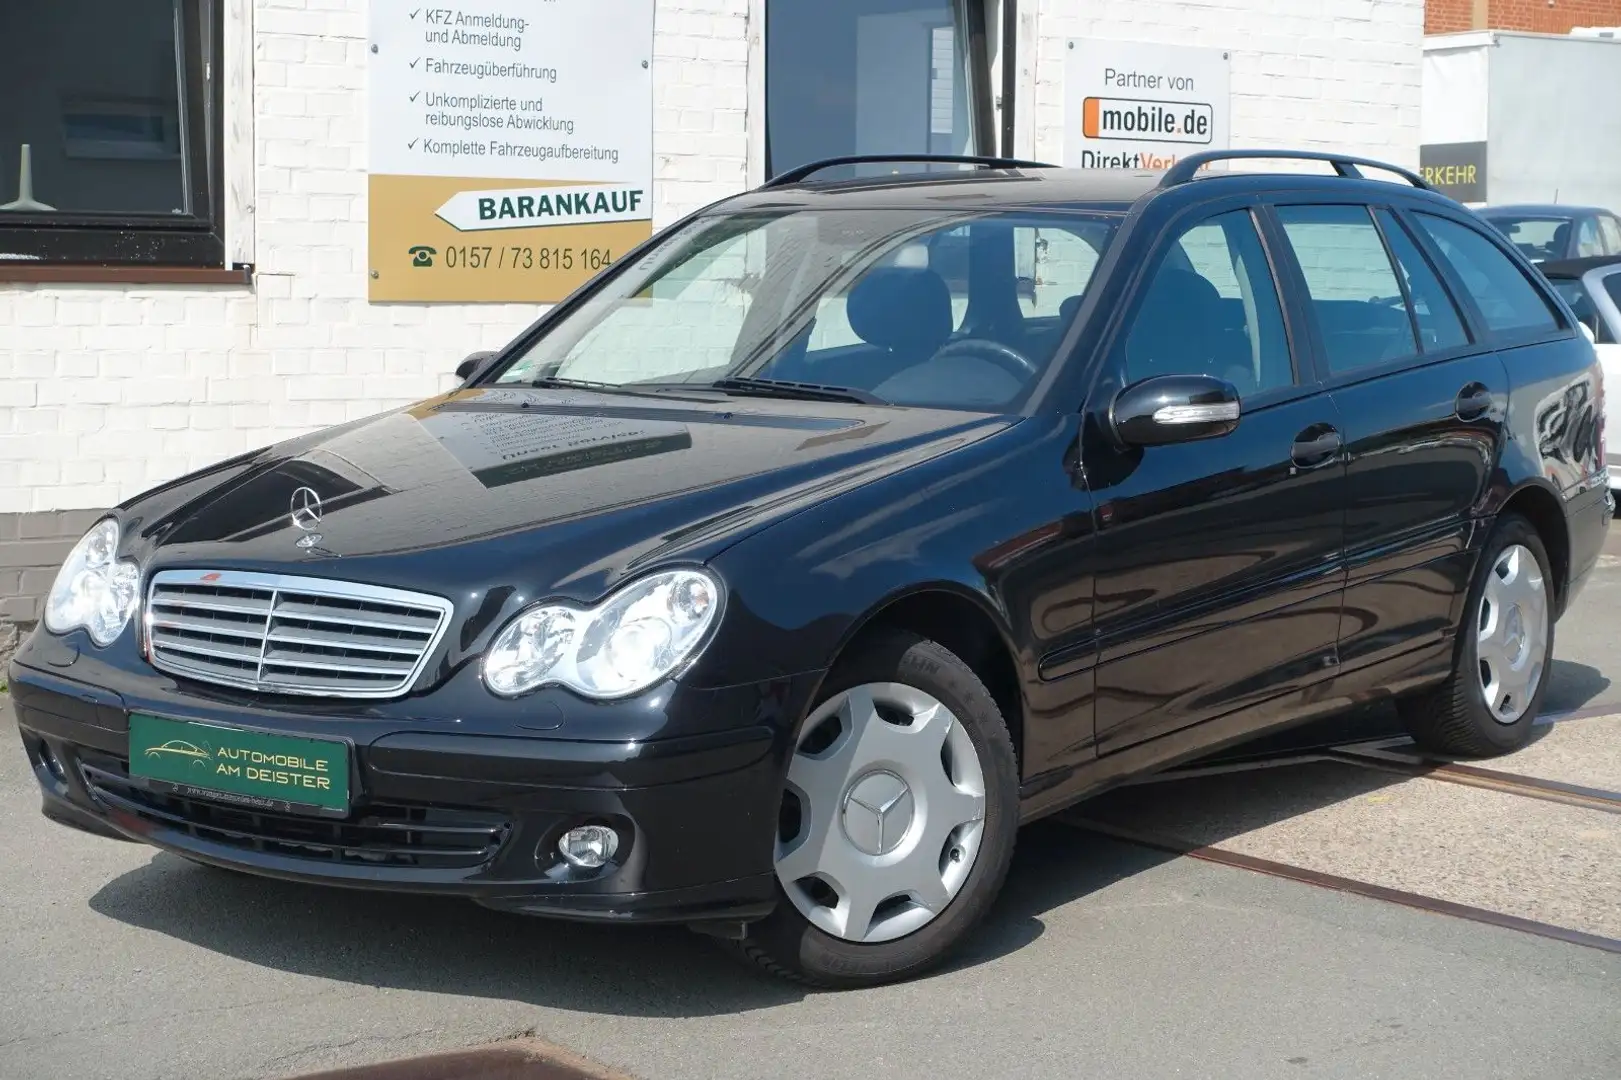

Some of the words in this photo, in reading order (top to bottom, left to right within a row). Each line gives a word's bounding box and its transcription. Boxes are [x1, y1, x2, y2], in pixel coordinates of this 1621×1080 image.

[425, 9, 453, 25] KFZ
[455, 11, 529, 33] Anmeldung-
[425, 29, 448, 44] und
[451, 30, 521, 51] Abmeldung
[425, 58, 557, 83] Fahrzeugüberführung
[1105, 68, 1163, 89] Partner
[1168, 77, 1193, 91] von
[425, 92, 517, 112] Unkomplizierte
[520, 97, 542, 112] und
[425, 113, 503, 131] reibungslose
[507, 115, 574, 134] Abwicklung
[1103, 106, 1207, 135] mobile.de
[423, 138, 486, 156] Komplette
[490, 141, 619, 164] Fahrzeugaufbereitung
[1420, 164, 1476, 185] RKEHR
[478, 189, 643, 220] BARANKAUF
[446, 246, 492, 269] 0157
[499, 248, 505, 269] /
[511, 248, 533, 269] 73
[540, 248, 573, 270] 815
[580, 248, 611, 270] 164
[217, 747, 329, 772] AUTOMOBILE
[216, 763, 240, 777] AM
[247, 768, 330, 790] DEISTER
